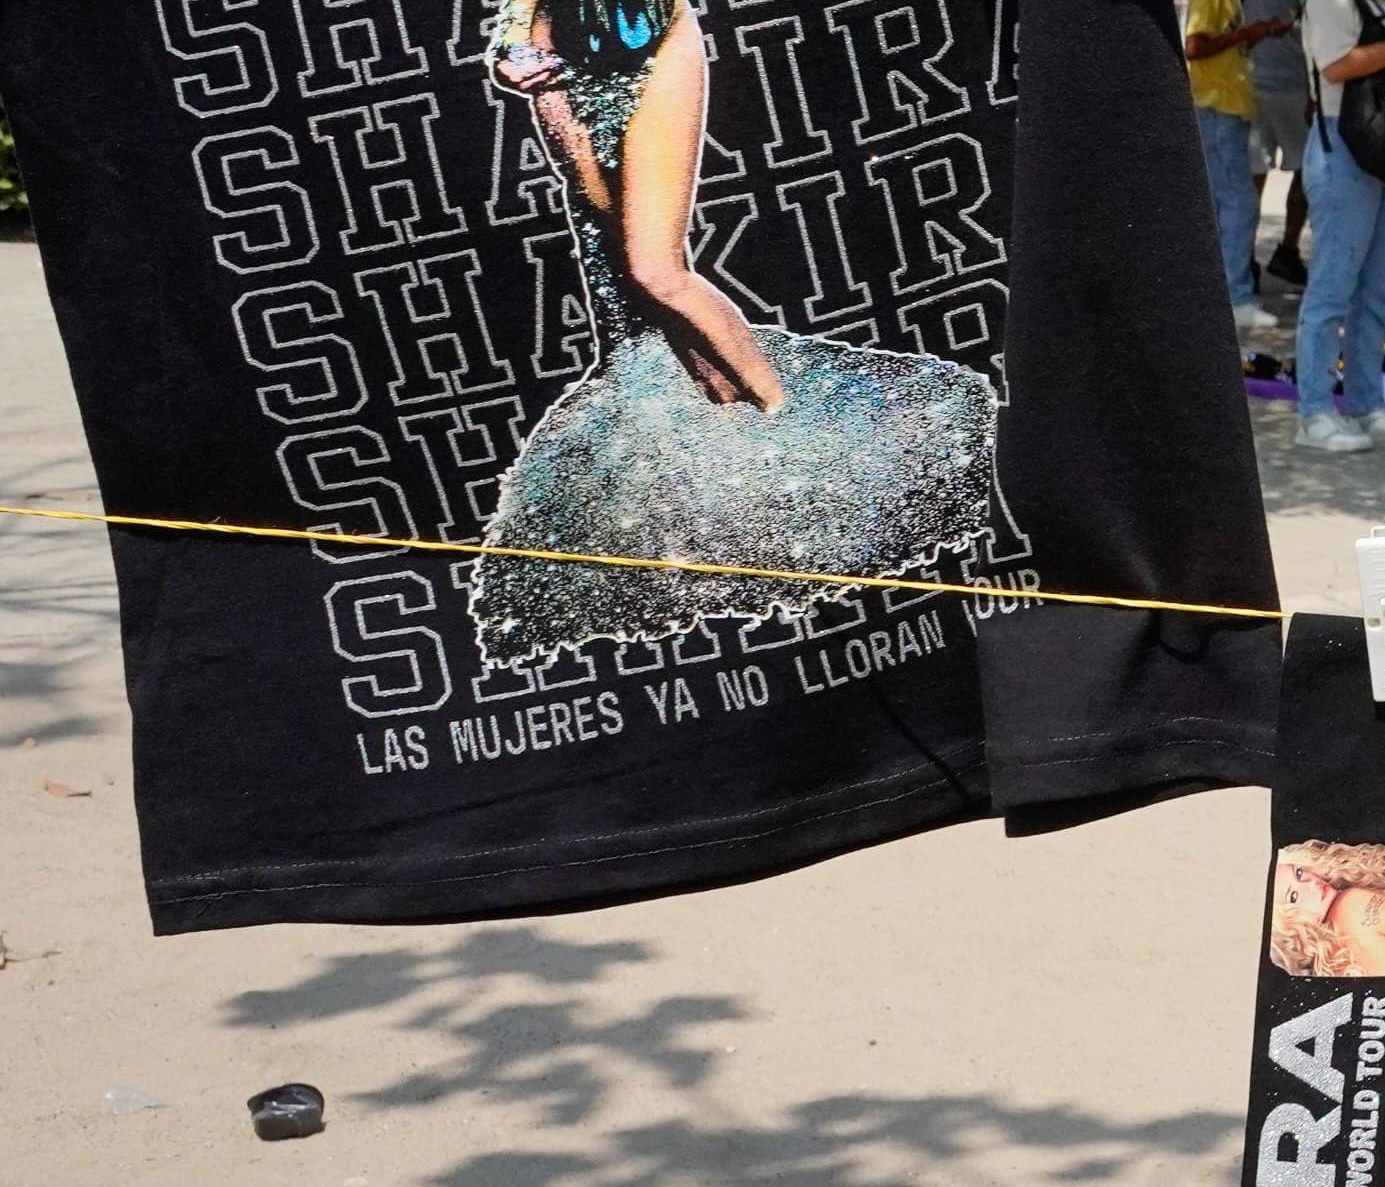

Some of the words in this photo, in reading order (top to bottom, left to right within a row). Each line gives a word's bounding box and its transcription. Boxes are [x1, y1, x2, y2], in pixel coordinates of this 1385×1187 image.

[355, 726, 430, 776] LAS
[449, 690, 624, 765] MUJERES
[645, 676, 700, 725] YA
[717, 664, 769, 713] NO
[793, 608, 947, 696] LLORAN
